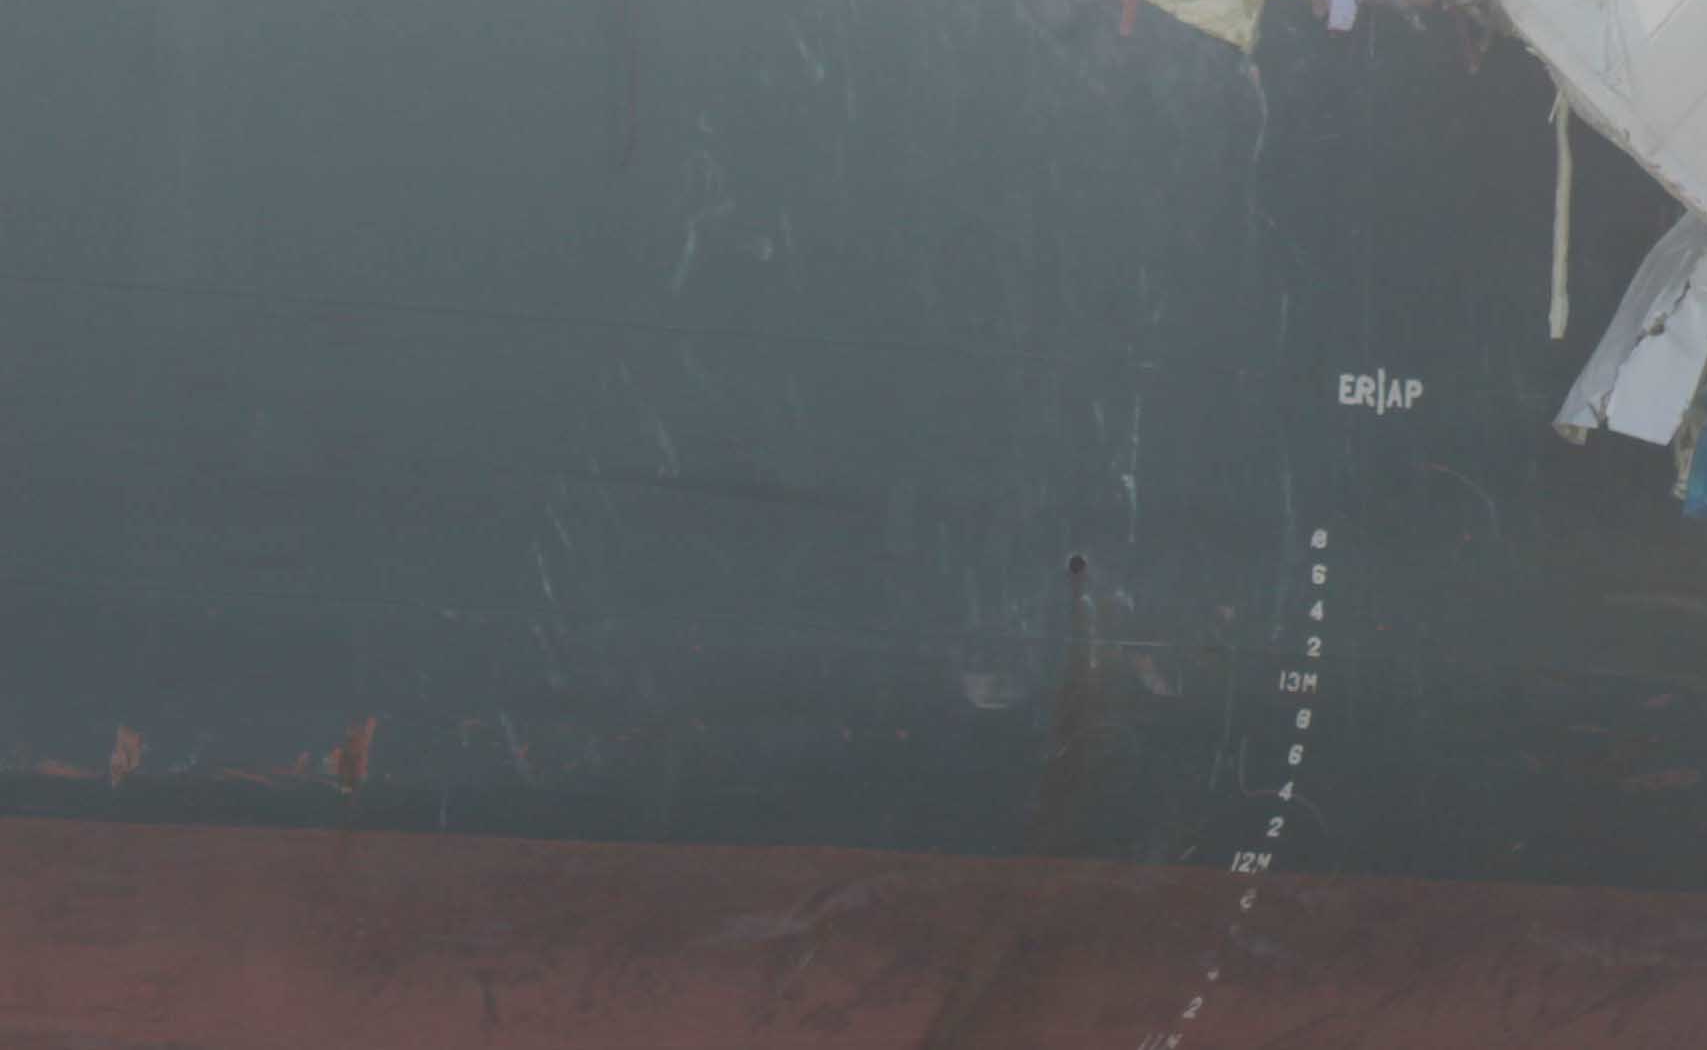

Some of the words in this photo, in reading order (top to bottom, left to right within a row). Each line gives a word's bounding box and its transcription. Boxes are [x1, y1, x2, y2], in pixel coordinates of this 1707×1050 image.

[1310, 527, 1328, 550] 8
[1311, 564, 1328, 587] 6
[1308, 599, 1325, 622] 4
[1305, 635, 1323, 658] 2
[1278, 669, 1319, 694] 13M
[1295, 707, 1313, 730] 8
[1287, 742, 1305, 766] 6
[1277, 779, 1296, 802] 4
[1265, 815, 1286, 838] 2
[1228, 849, 1273, 875] 12M
